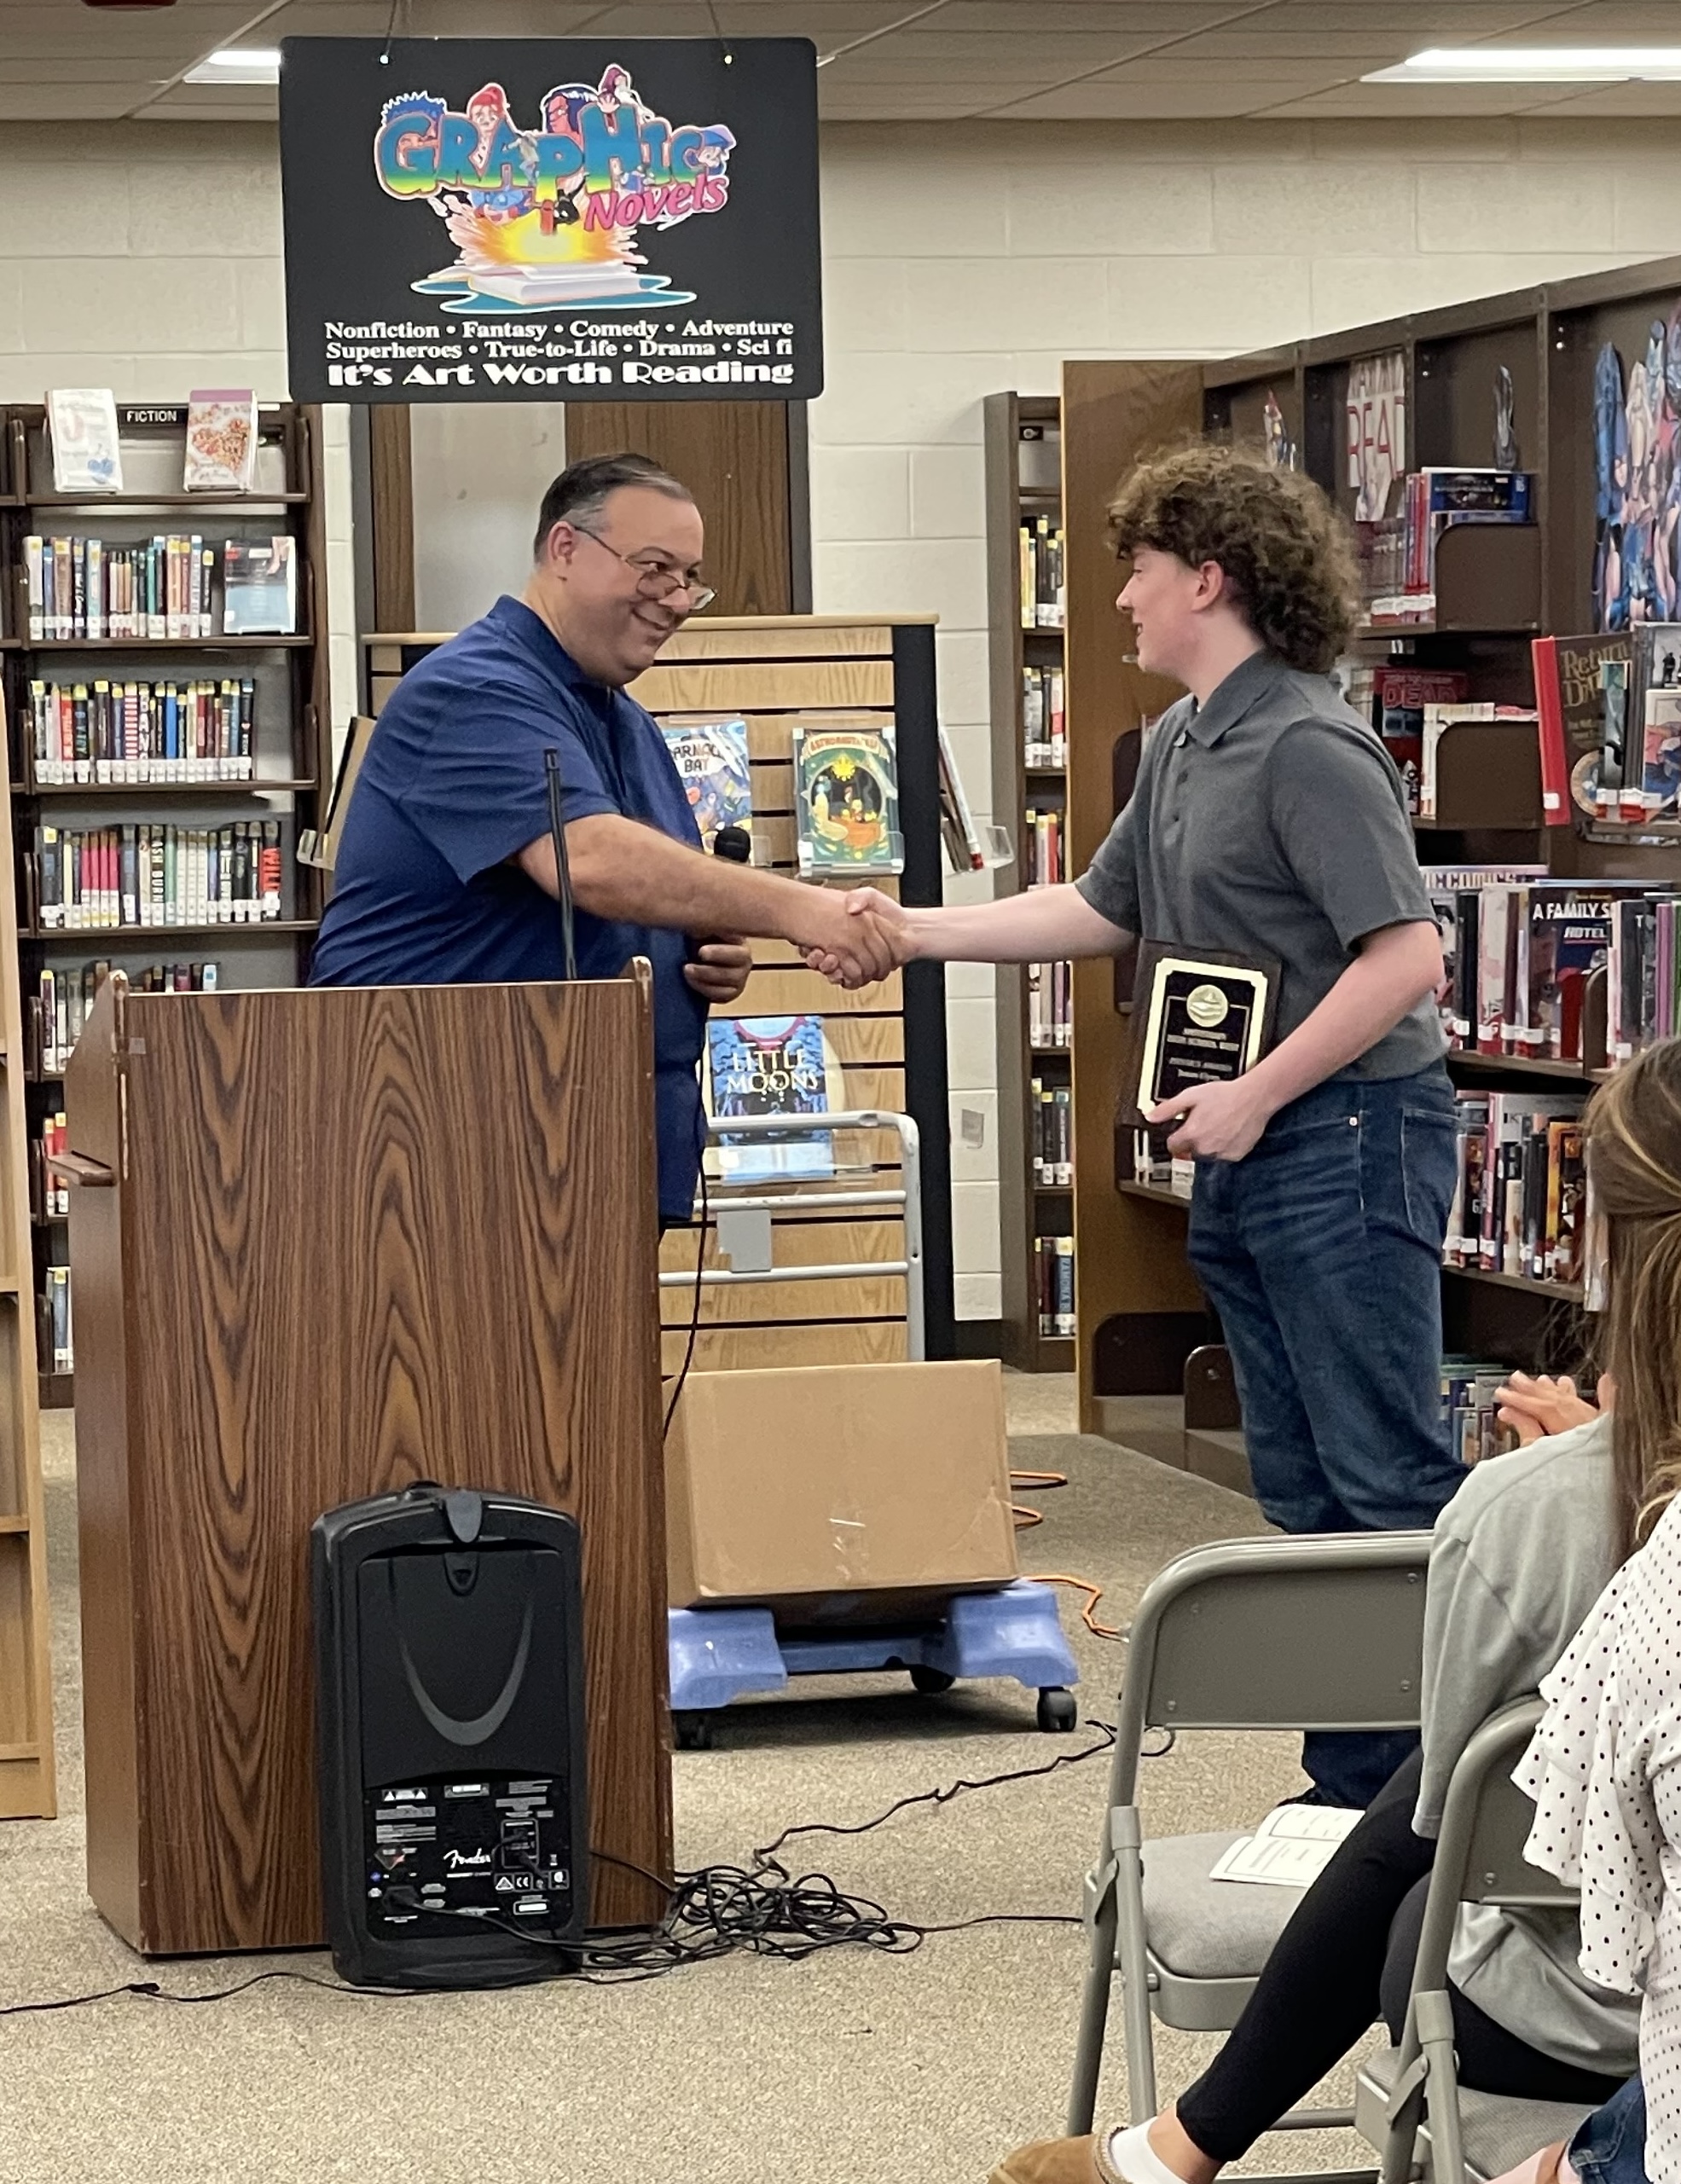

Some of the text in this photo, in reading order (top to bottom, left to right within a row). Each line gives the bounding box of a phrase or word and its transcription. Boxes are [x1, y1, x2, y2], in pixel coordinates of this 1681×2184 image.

[380, 103, 706, 202] GRAPHIC
[583, 175, 727, 231] Novels
[324, 320, 794, 341] Nonfiction Fantasy Comedy Adventure
[326, 339, 793, 362] Superheroes True-to-Life Drama Sci fi
[328, 361, 795, 385] It's Art Worth Reading
[126, 409, 177, 422] FICTION
[1560, 641, 1629, 681] Return
[685, 758, 709, 773] BAY
[152, 840, 165, 903] ASH BURN
[1533, 902, 1544, 920] A
[1547, 902, 1599, 918] FAMILY
[733, 1048, 805, 1073] LITTLE
[727, 1070, 819, 1093] MOONS
[443, 1847, 492, 1868] Fender
